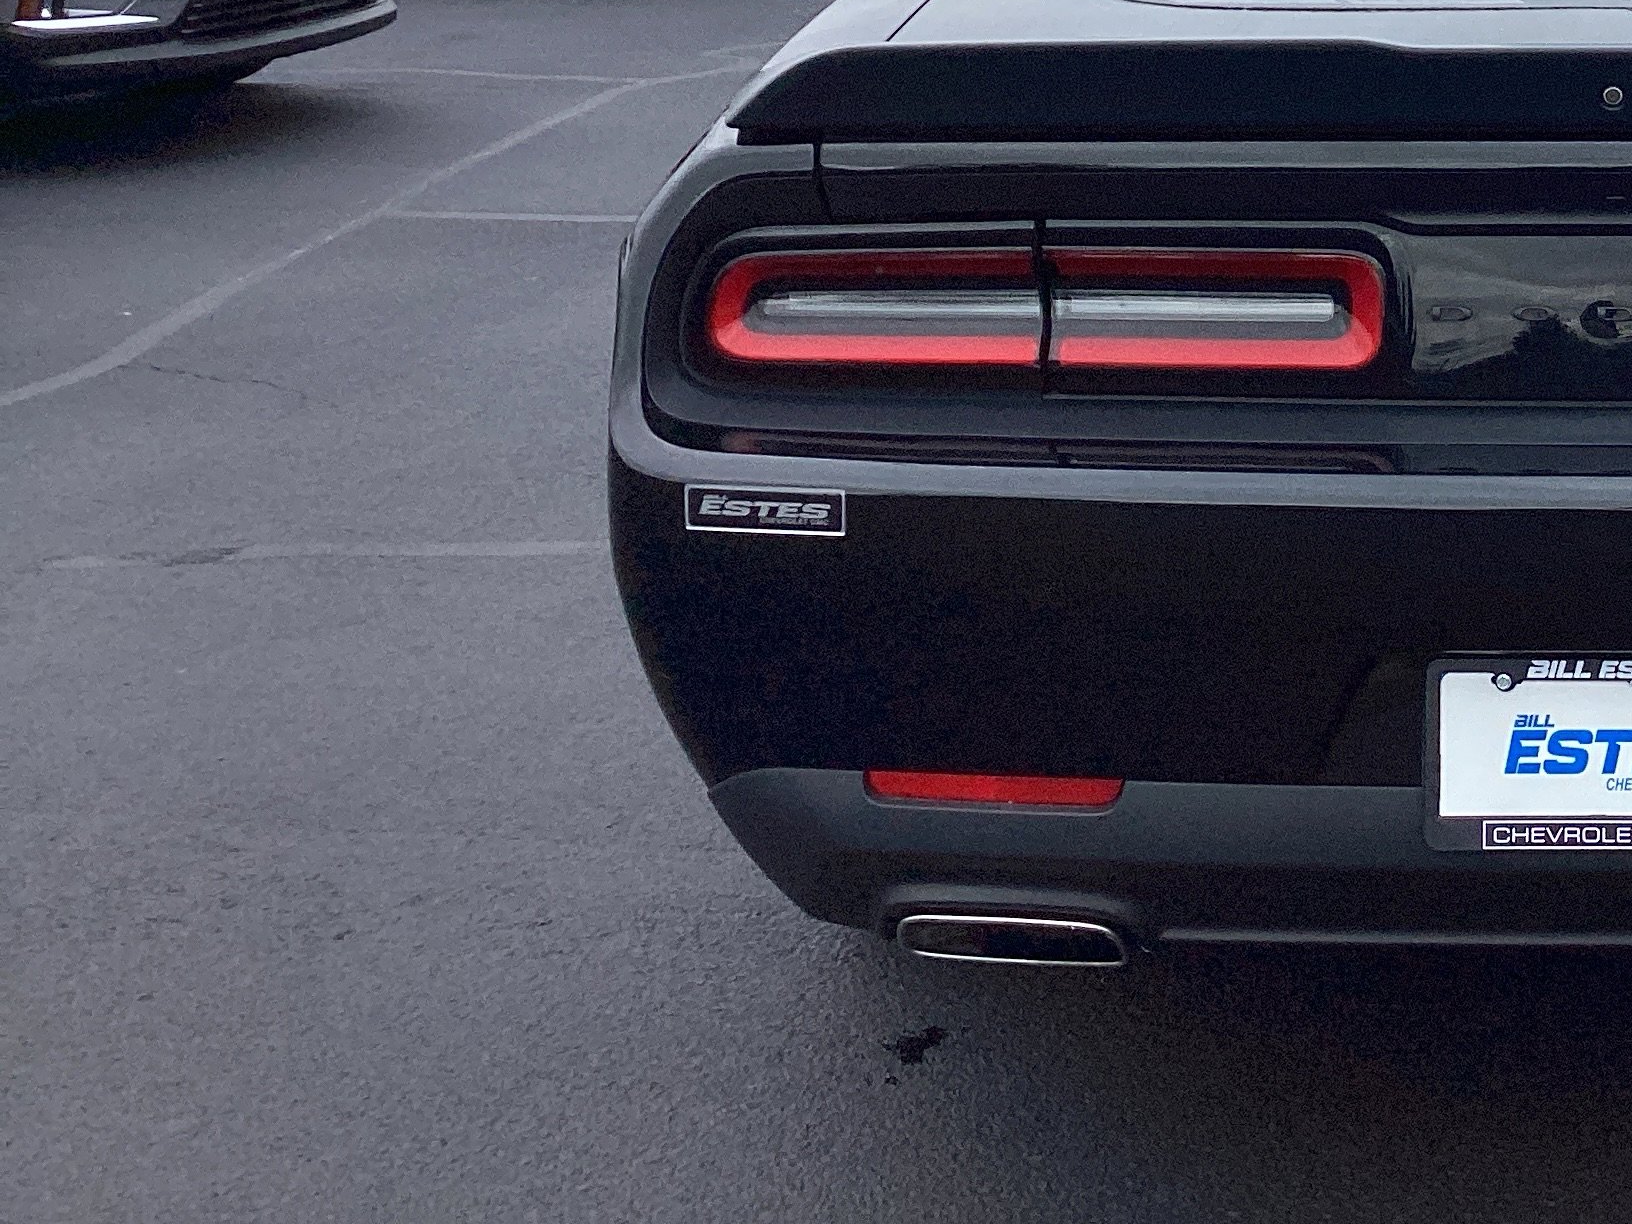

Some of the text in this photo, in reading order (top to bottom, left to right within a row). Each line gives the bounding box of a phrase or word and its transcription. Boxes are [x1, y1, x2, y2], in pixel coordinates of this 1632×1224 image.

[698, 499, 831, 519] ESTES
[1527, 659, 1591, 679] BILL
[1513, 714, 1555, 728] BILL
